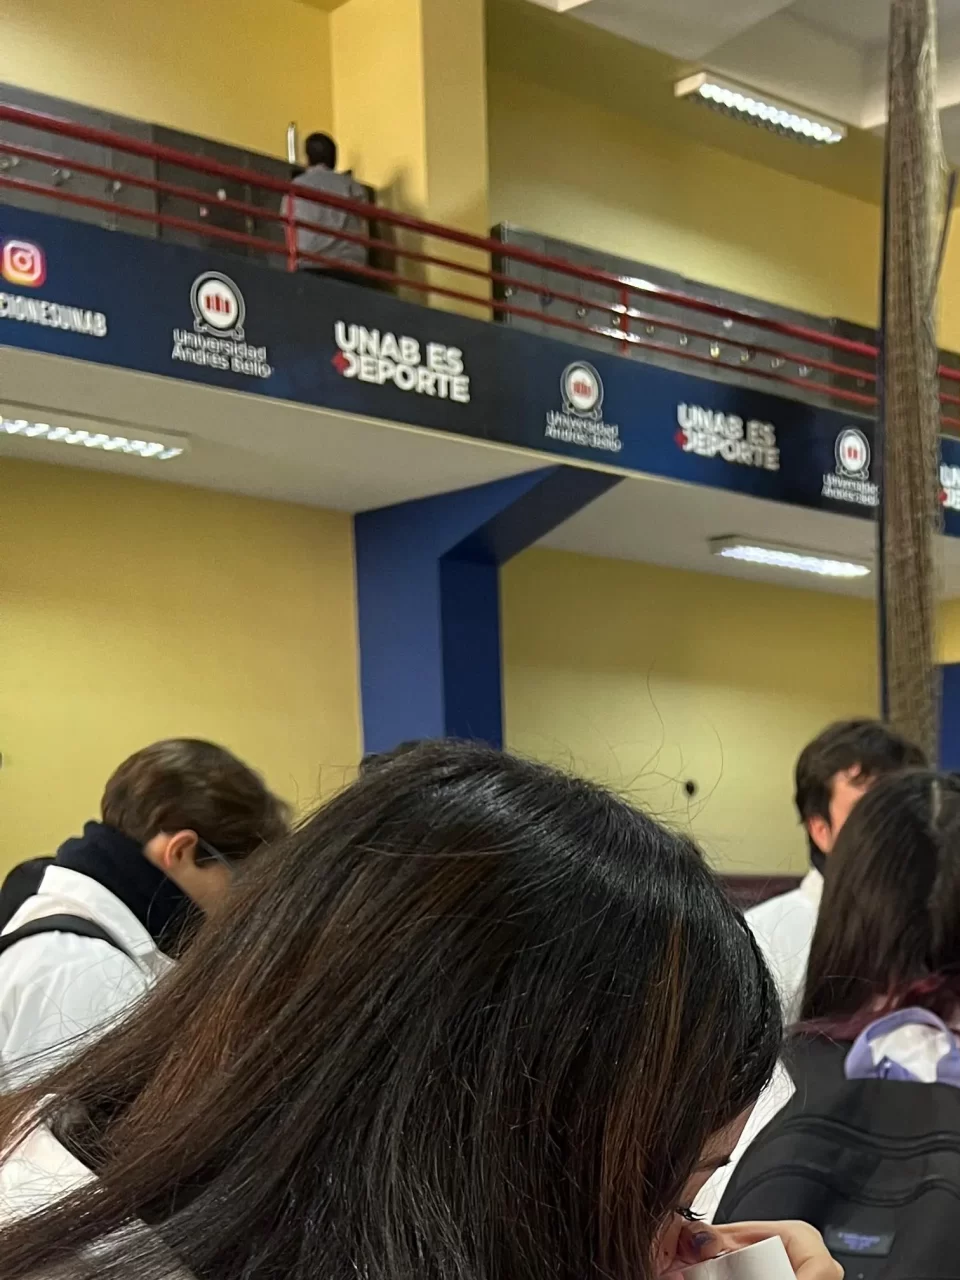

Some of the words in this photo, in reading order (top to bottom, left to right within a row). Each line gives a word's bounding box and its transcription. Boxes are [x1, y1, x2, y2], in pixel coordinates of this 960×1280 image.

[173, 328, 267, 362] Universidad
[334, 320, 421, 366] UNAB
[426, 341, 464, 376] ES
[341, 350, 470, 403] DEPORTE
[677, 402, 744, 440] UNAB
[746, 420, 776, 447] ES
[680, 429, 780, 470] DEPORTE
